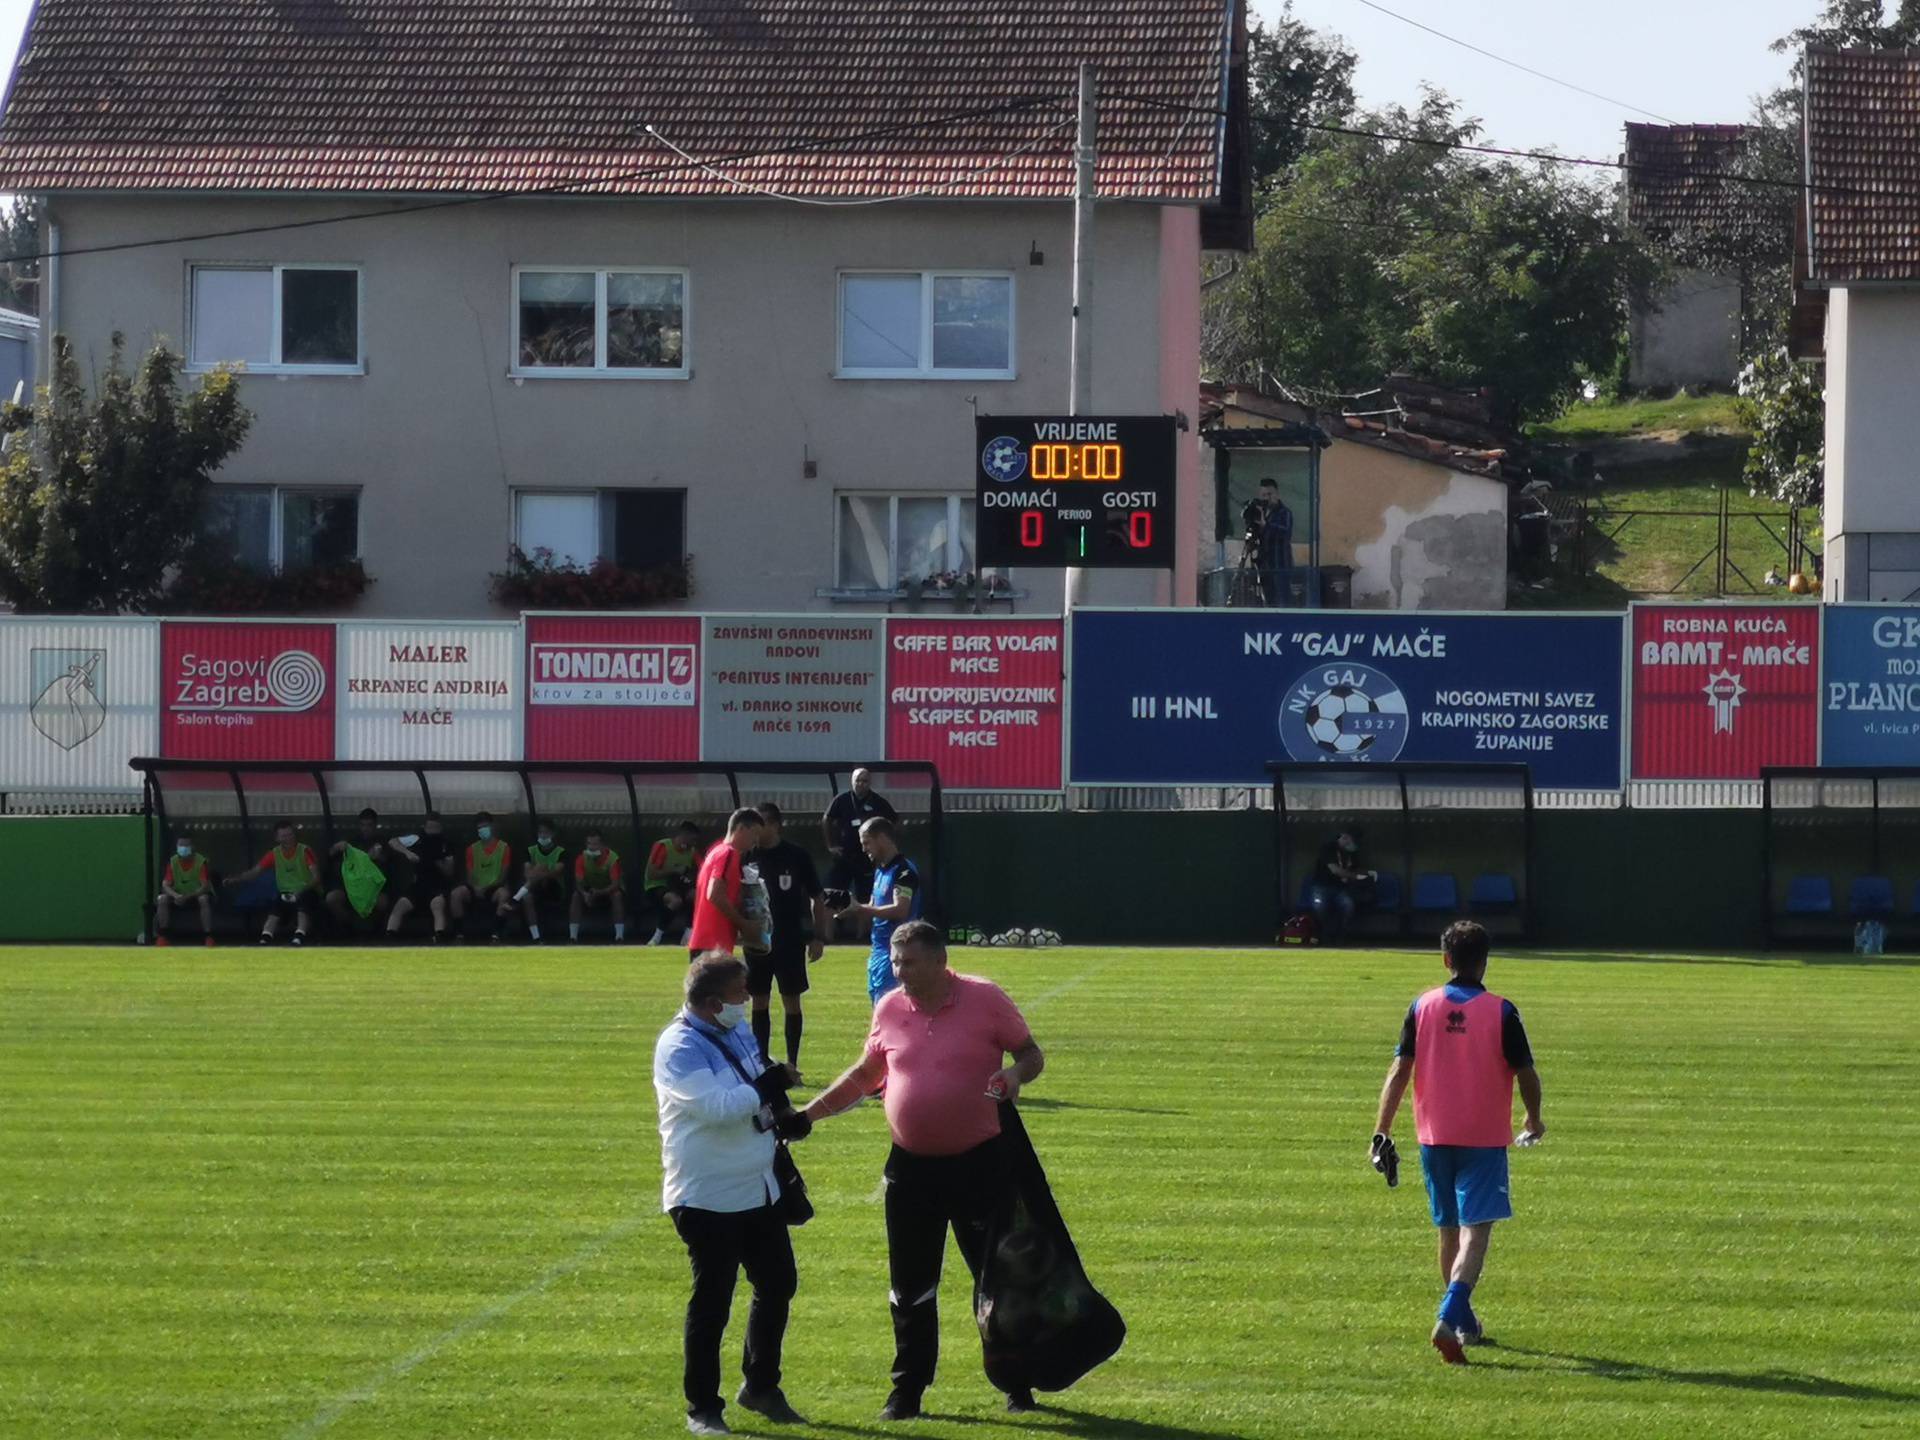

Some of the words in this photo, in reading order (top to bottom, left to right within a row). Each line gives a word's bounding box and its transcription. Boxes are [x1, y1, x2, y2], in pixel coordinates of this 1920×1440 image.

[1034, 423, 1117, 440] VRIJEME
[1032, 445, 1120, 479] 00:00
[983, 488, 1057, 508] DOMAĆI
[1103, 491, 1157, 508] GOSTI
[1058, 509, 1092, 520] PERIOD
[1021, 511, 1043, 547] 0
[1130, 511, 1152, 548] 0
[1664, 619, 1728, 633] ROBNA
[1734, 615, 1787, 633] KUĆA
[893, 635, 947, 652] CAFFE
[952, 635, 992, 652] BAR
[996, 635, 1057, 652] VOLAN
[1244, 632, 1282, 655] NK
[1372, 627, 1446, 657] MAČE
[390, 645, 468, 663] MALER
[1642, 641, 1723, 665] BAMT
[1743, 639, 1809, 665] MAČE
[181, 654, 266, 682] Sagovi
[538, 652, 659, 679] TONDACH
[177, 681, 269, 707] Zagreb
[348, 679, 428, 694] KRPANEC
[433, 680, 508, 697] ANDRIJA
[533, 688, 573, 699] krov
[584, 689, 602, 699] za
[615, 688, 692, 702] stoljeća
[891, 687, 1057, 705] AUTOPRIJEVOZNIK
[1288, 684, 1317, 714] NK
[1323, 670, 1367, 688] GAJ
[722, 700, 738, 712] vl.
[742, 700, 793, 712] DARKO
[1132, 697, 1156, 718] III
[1165, 697, 1218, 719] HNL
[1436, 691, 1539, 707] NOGOMETNI
[1544, 692, 1596, 708] SAVEZ
[177, 713, 211, 725] Salon
[214, 713, 254, 727] tepiha
[402, 708, 453, 725] MAČE
[752, 717, 792, 732] MAČE
[797, 720, 831, 733] 169A
[979, 709, 1039, 726] DAMIR
[1354, 719, 1395, 729] 1927
[1421, 712, 1515, 729] KRAPINSKO
[1520, 713, 1609, 730] ZAGORSKE
[1881, 723, 1909, 734] Ivica
[1475, 731, 1553, 750] ŽUPANIJE
